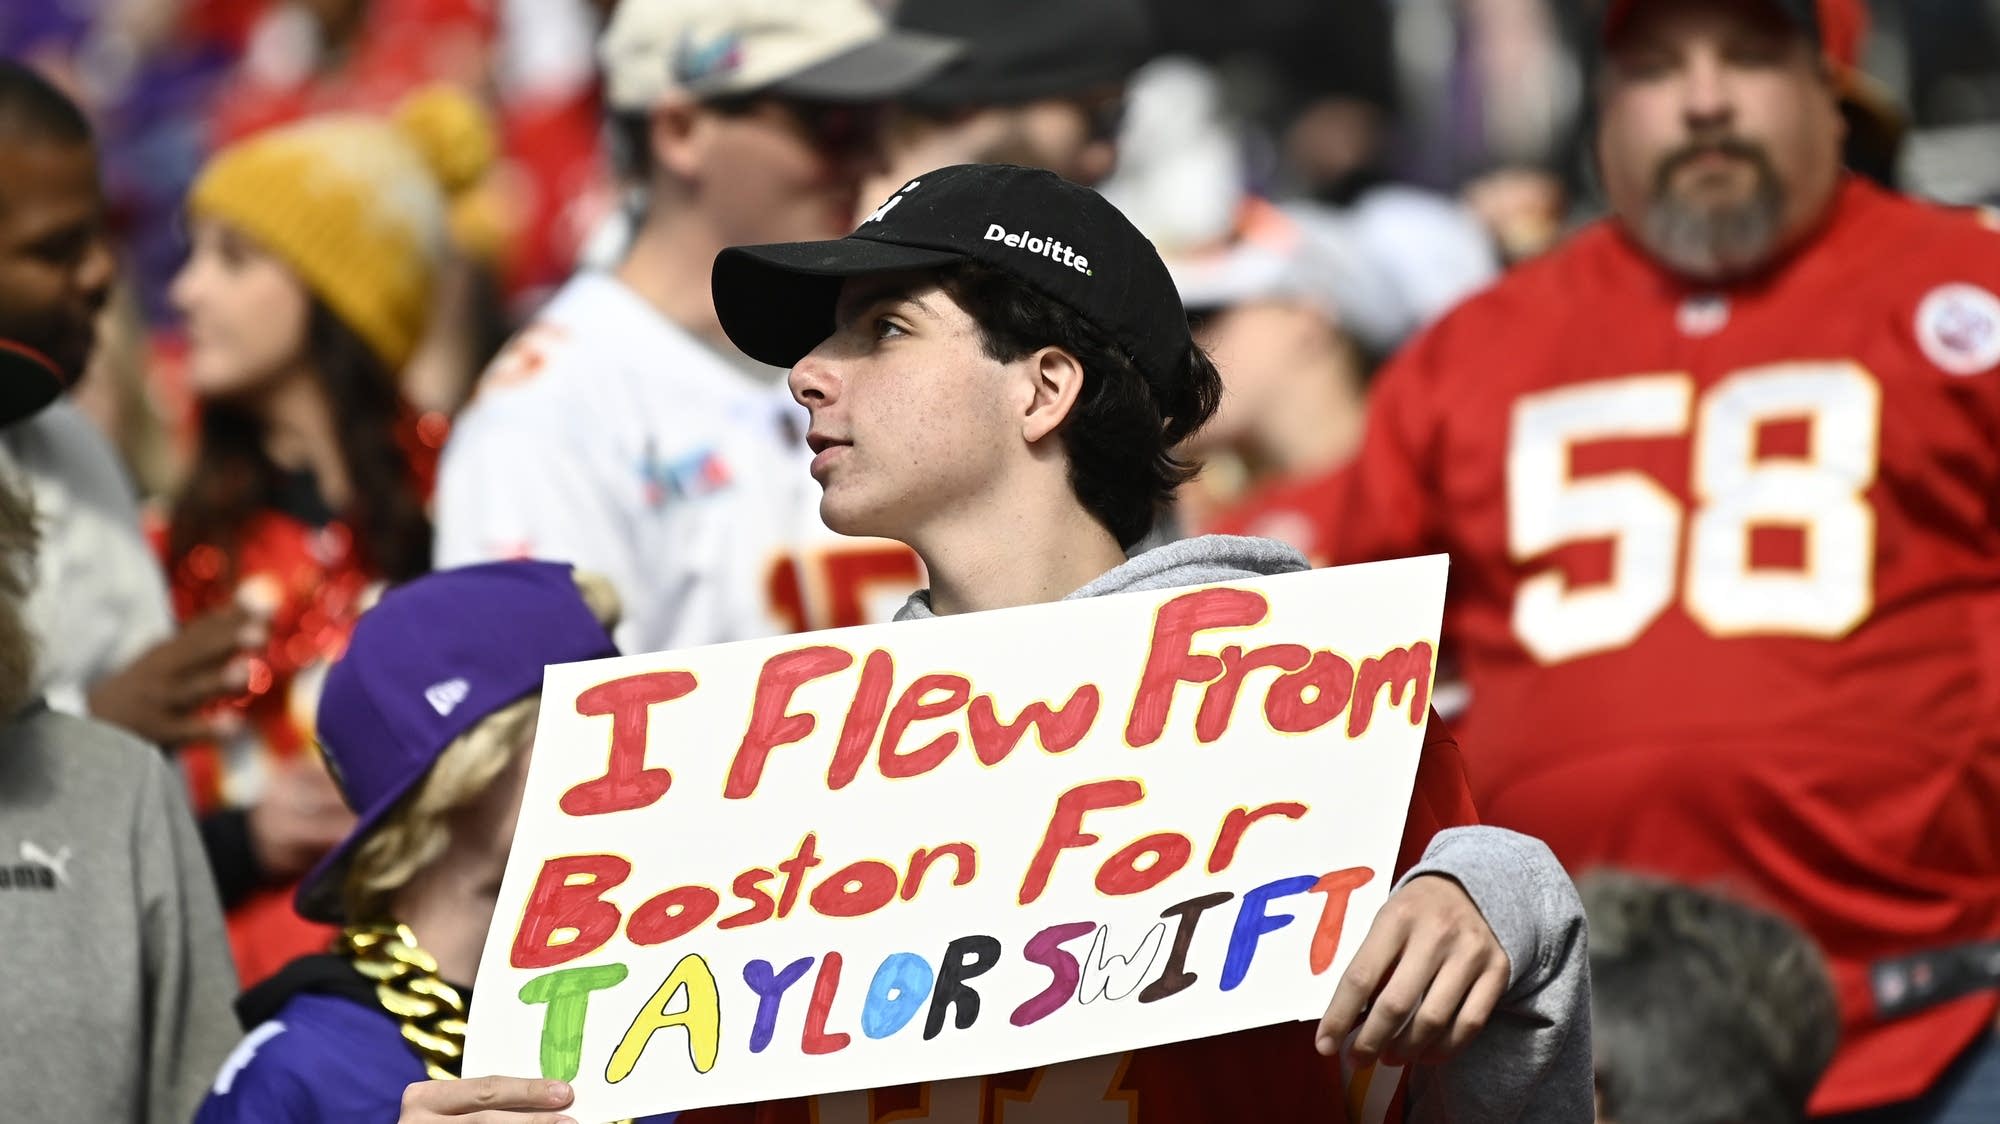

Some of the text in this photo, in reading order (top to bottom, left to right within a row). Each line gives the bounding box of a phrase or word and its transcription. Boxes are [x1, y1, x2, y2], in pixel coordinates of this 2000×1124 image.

[984, 224, 1092, 276] Deloitte.
[1508, 360, 1881, 664] 58
[559, 587, 1432, 817] I Flew From
[510, 778, 1308, 969] Boston For
[518, 866, 1375, 1084] TAYLOR SWIFT
